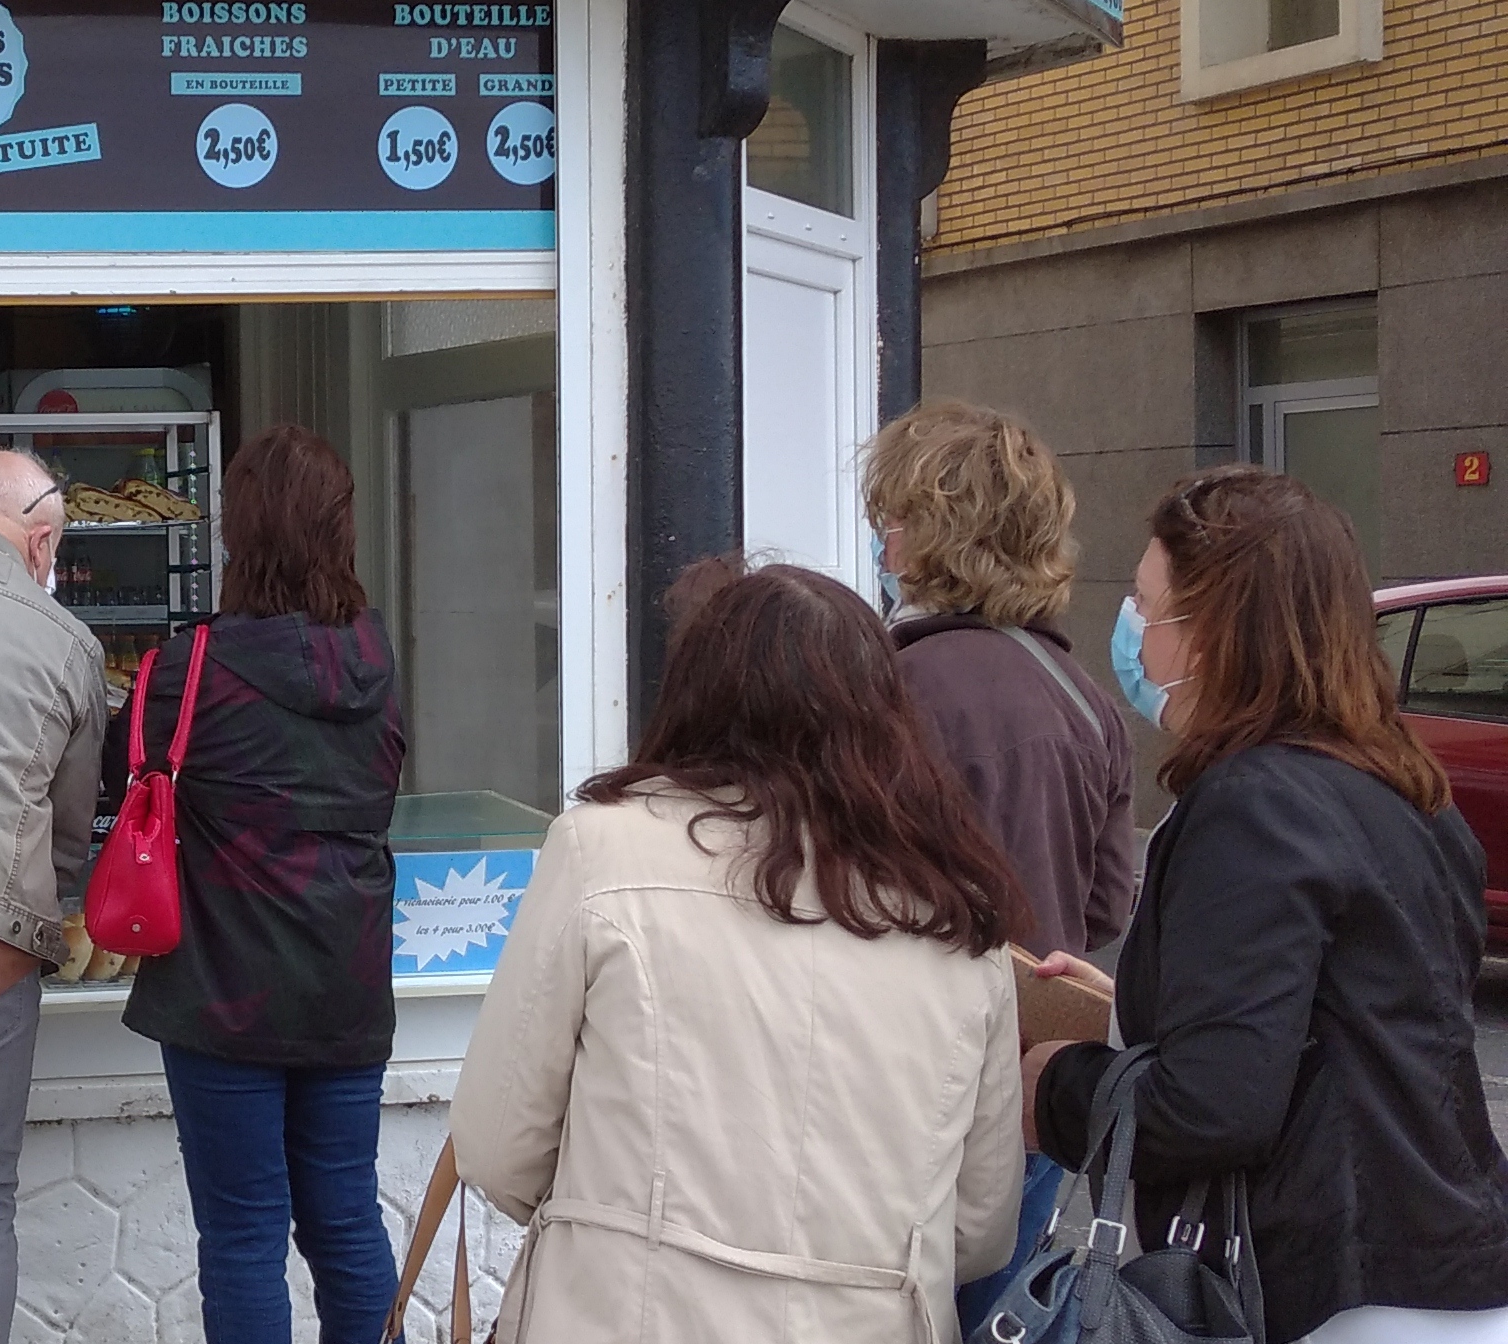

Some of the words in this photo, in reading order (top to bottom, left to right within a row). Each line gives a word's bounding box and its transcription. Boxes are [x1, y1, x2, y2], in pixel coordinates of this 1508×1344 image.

[162, 2, 307, 25] BOISSONS
[394, 4, 551, 28] BOUTEILLE
[162, 36, 308, 58] FRAICHES
[429, 37, 517, 59] D'EAU
[185, 79, 207, 90] EN
[209, 79, 290, 91] BOUTEILLE
[383, 78, 453, 93] PETITE
[483, 78, 554, 92] GRAND
[203, 128, 271, 169] 2,50€
[385, 130, 452, 172] 1,50€
[1464, 457, 1479, 481] 2
[458, 896, 481, 908] pour
[441, 926, 464, 937] pour
